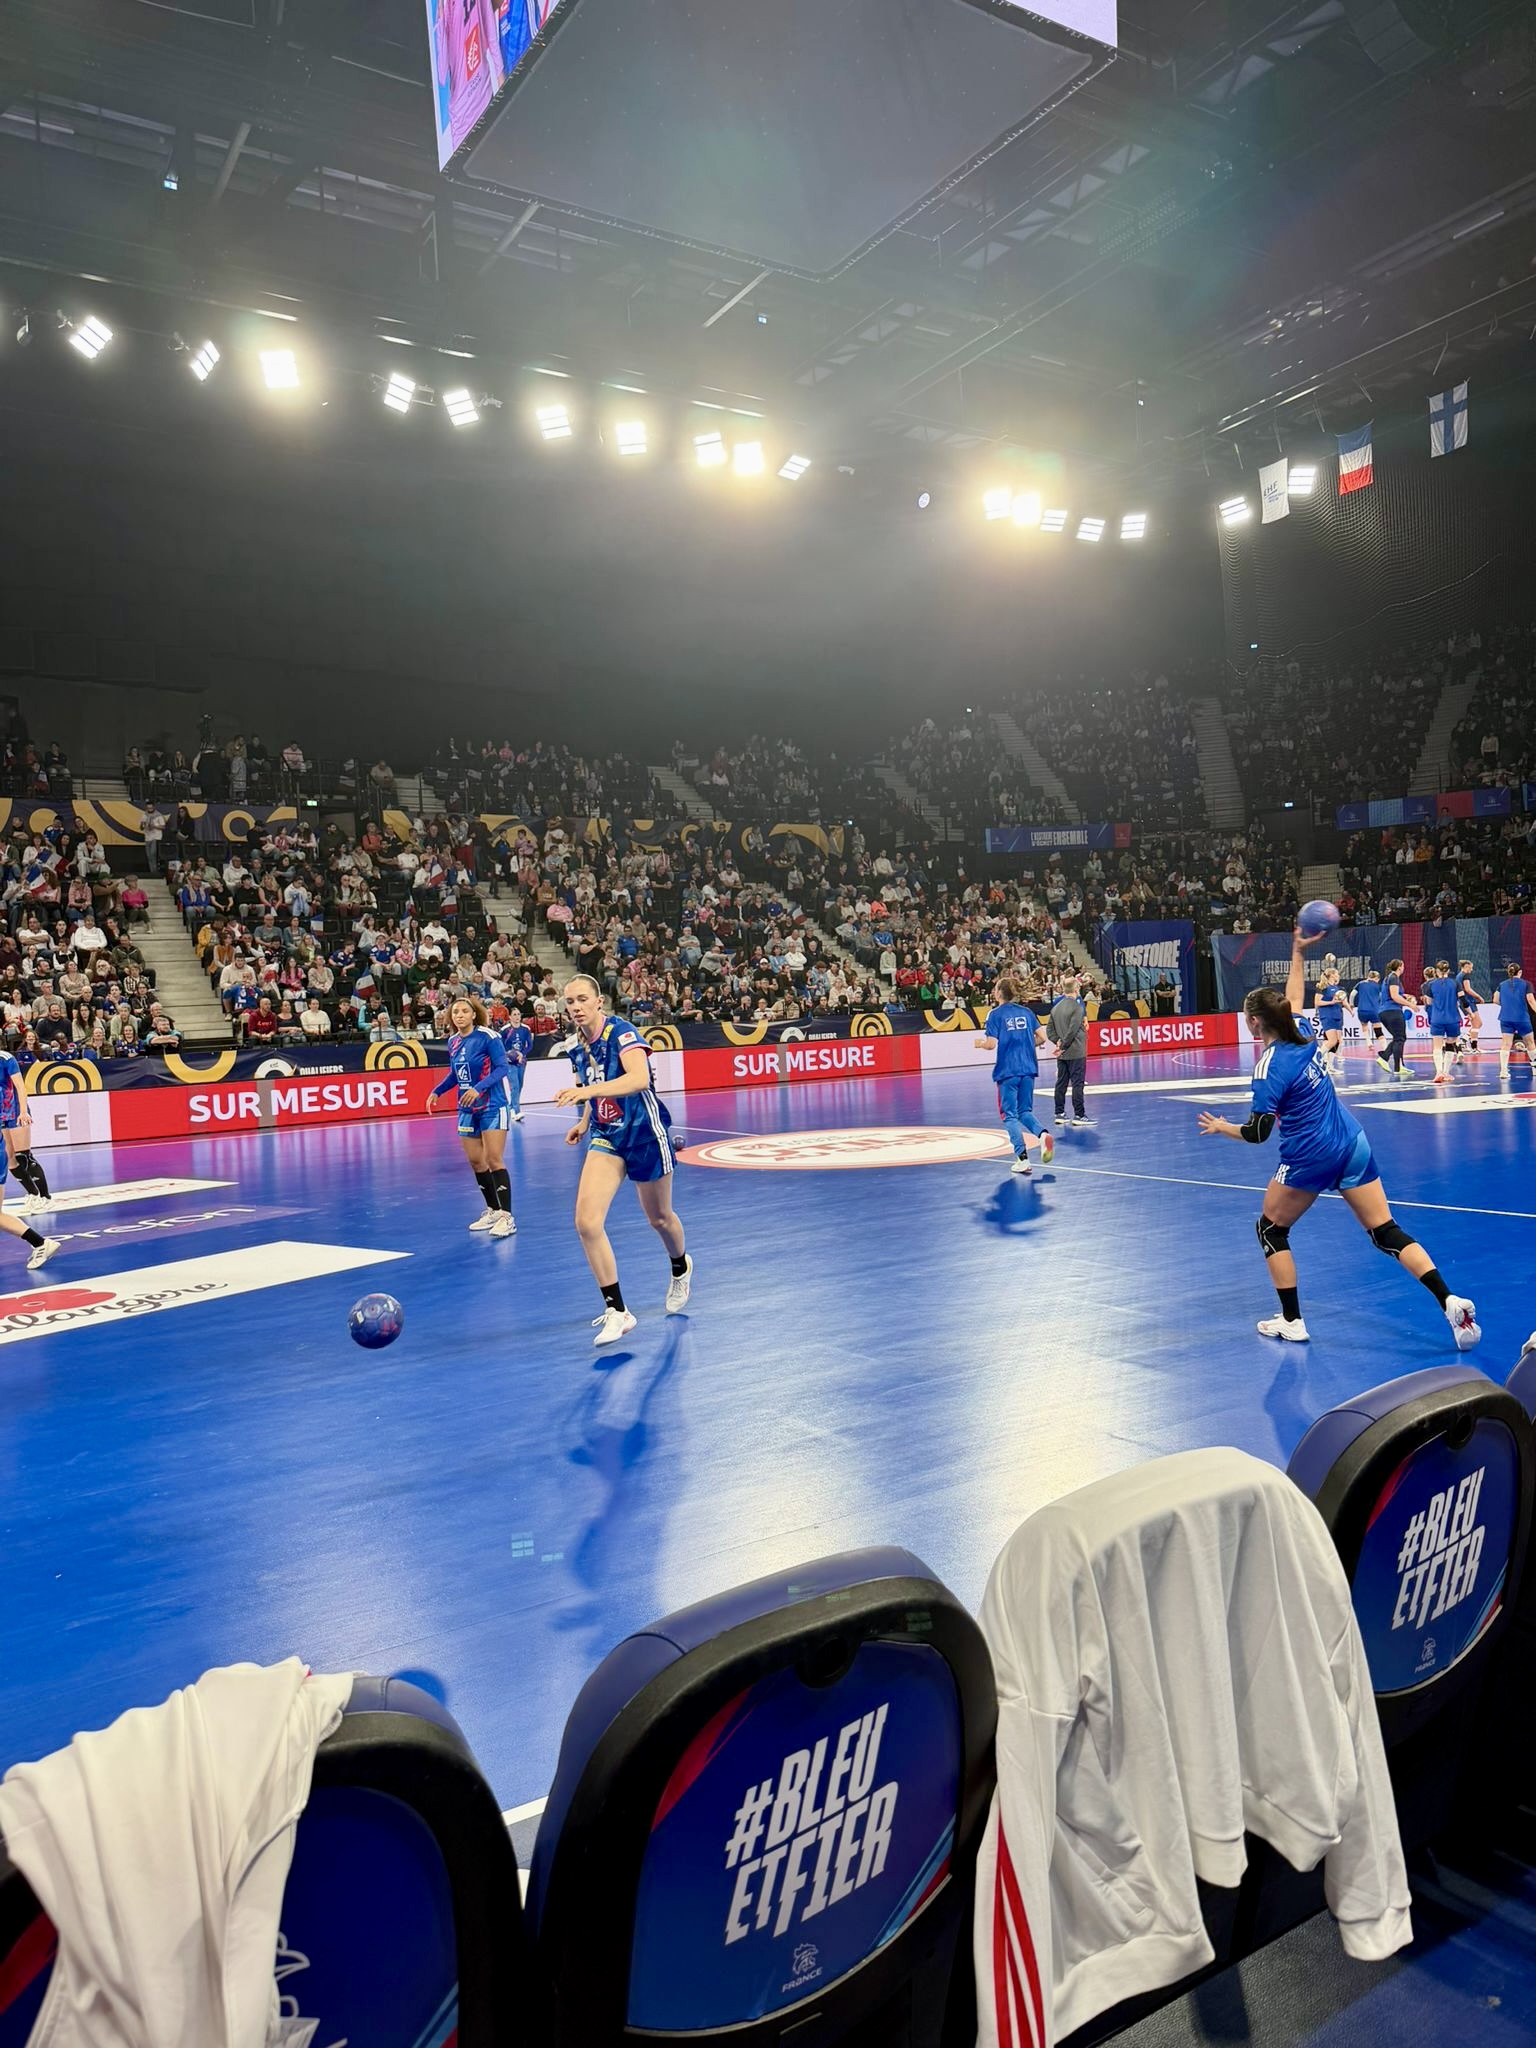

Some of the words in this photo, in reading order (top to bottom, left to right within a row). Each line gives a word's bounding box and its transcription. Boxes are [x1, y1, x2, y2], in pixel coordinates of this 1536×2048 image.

[1099, 1026, 1134, 1047] SUR
[1137, 1022, 1205, 1044] MESURE
[733, 1052, 781, 1077] SUR
[785, 1045, 876, 1073] MESURE
[188, 1091, 262, 1123] SUR
[270, 1080, 409, 1116] MESURE
[1396, 1466, 1486, 1574] #BLEU
[724, 1702, 889, 1870] #BLEU
